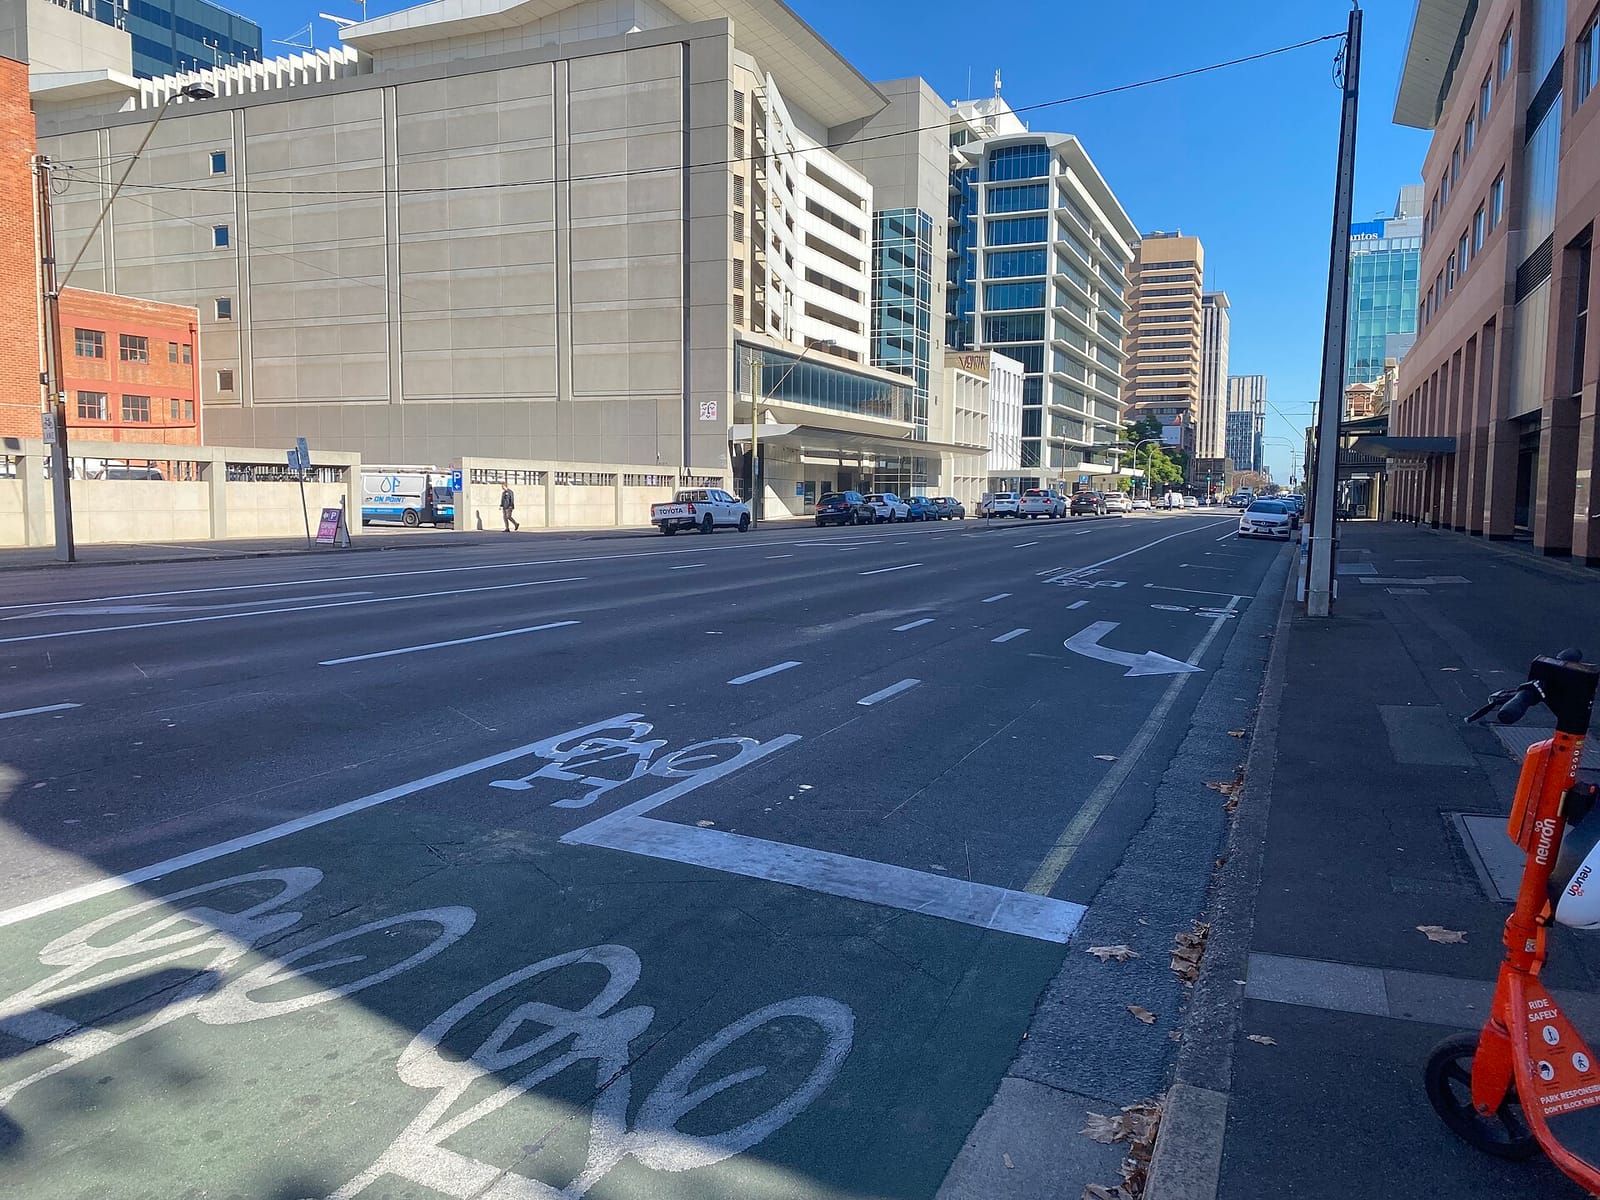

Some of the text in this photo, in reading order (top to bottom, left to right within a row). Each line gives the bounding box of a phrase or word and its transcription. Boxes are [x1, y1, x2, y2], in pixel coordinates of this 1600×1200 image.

[453, 472, 461, 483] P
[330, 511, 337, 520] P
[659, 507, 683, 515] TOYOTA
[1535, 818, 1557, 865] neuron
[1567, 865, 1592, 897] neuron
[1528, 999, 1549, 1010] RIDE
[1528, 1009, 1558, 1022] SAFELY
[1540, 1094, 1560, 1104] PARK
[1543, 1104, 1562, 1114] DON'T
[1563, 1100, 1583, 1110] BLOCK
